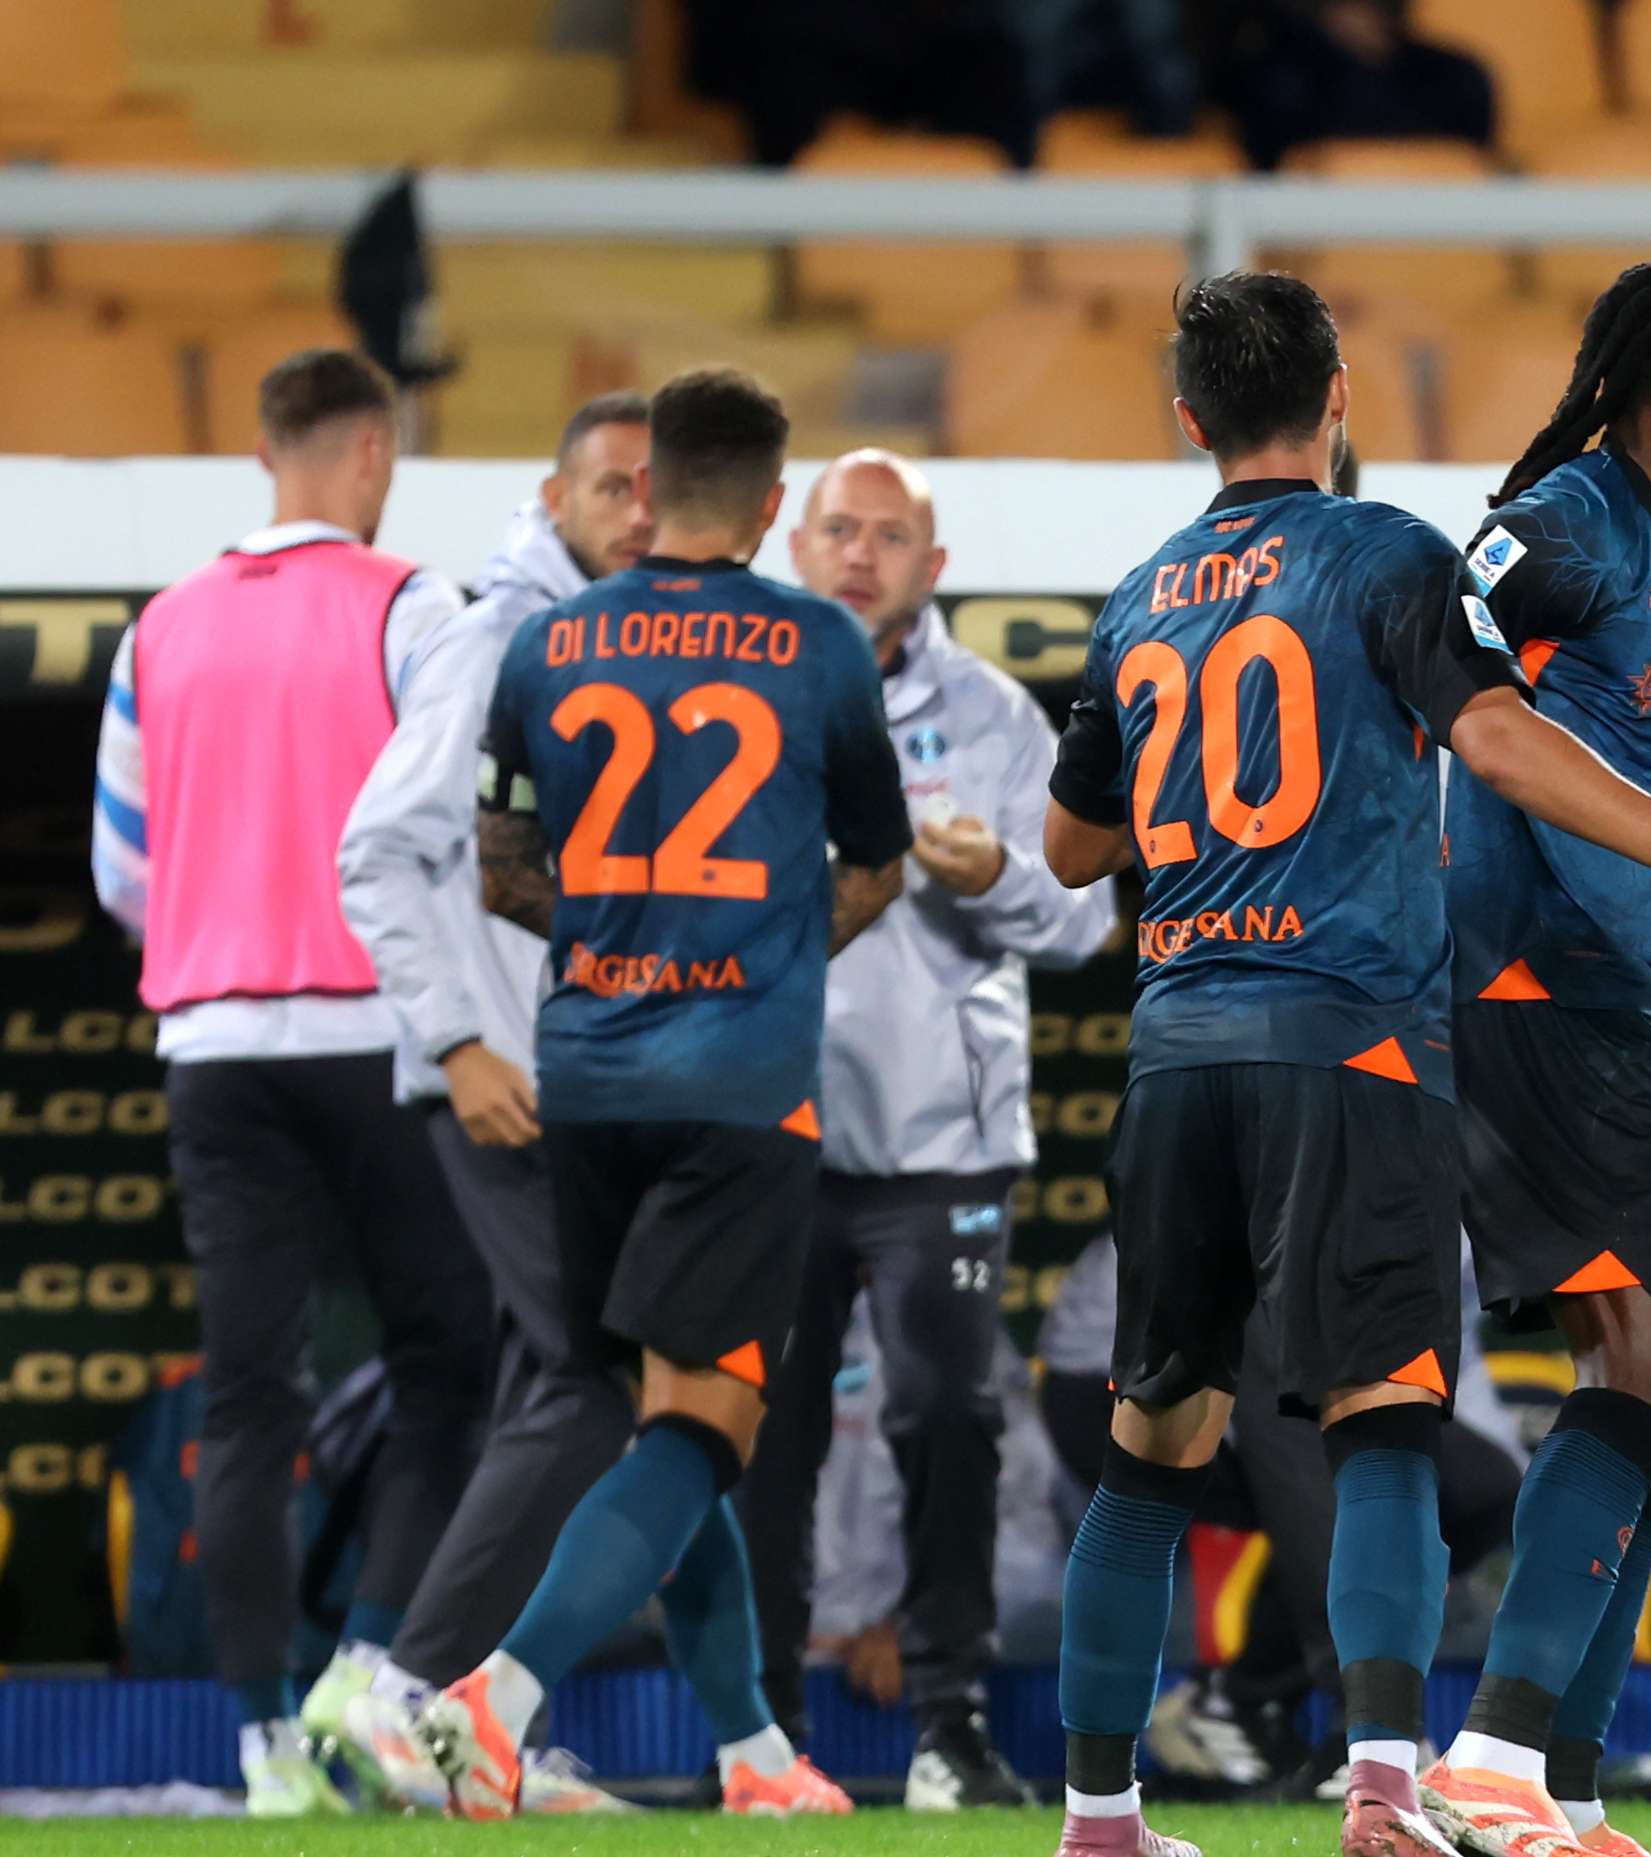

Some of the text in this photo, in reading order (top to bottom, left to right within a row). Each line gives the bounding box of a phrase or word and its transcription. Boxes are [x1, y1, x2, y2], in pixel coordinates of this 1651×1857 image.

[545, 610, 800, 668] DI LORENZO
[1149, 535, 1284, 614] ELMAS
[549, 681, 783, 900] 22
[1116, 614, 1322, 870] 20
